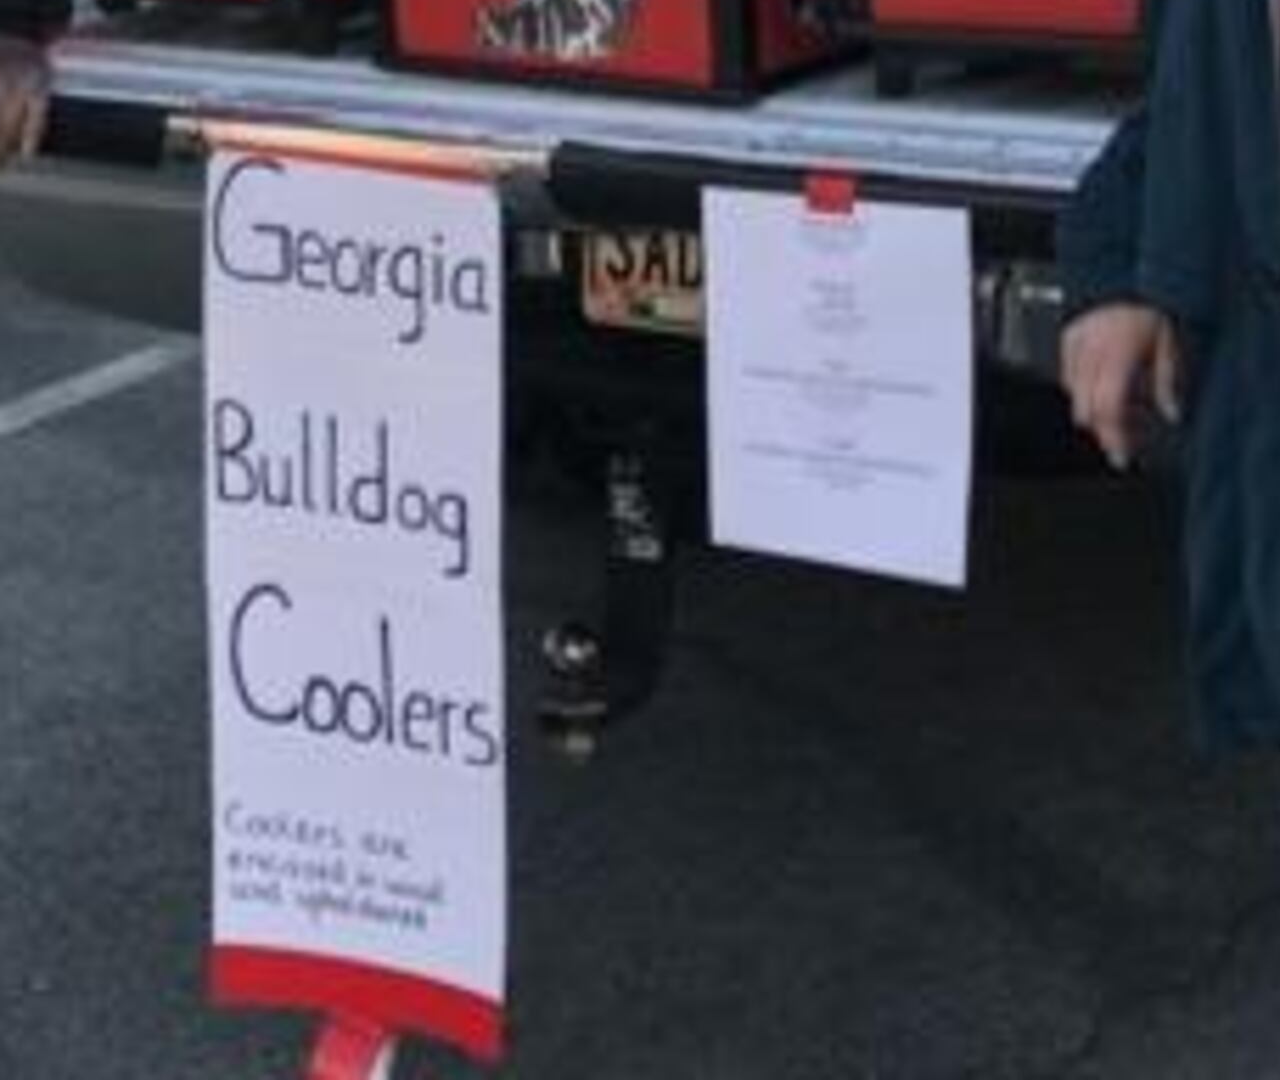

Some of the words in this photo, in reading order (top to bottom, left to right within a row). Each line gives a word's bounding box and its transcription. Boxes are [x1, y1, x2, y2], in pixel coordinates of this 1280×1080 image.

[213, 156, 490, 344] Georgia
[214, 398, 470, 579] Bulldog
[228, 583, 499, 767] Coolers
